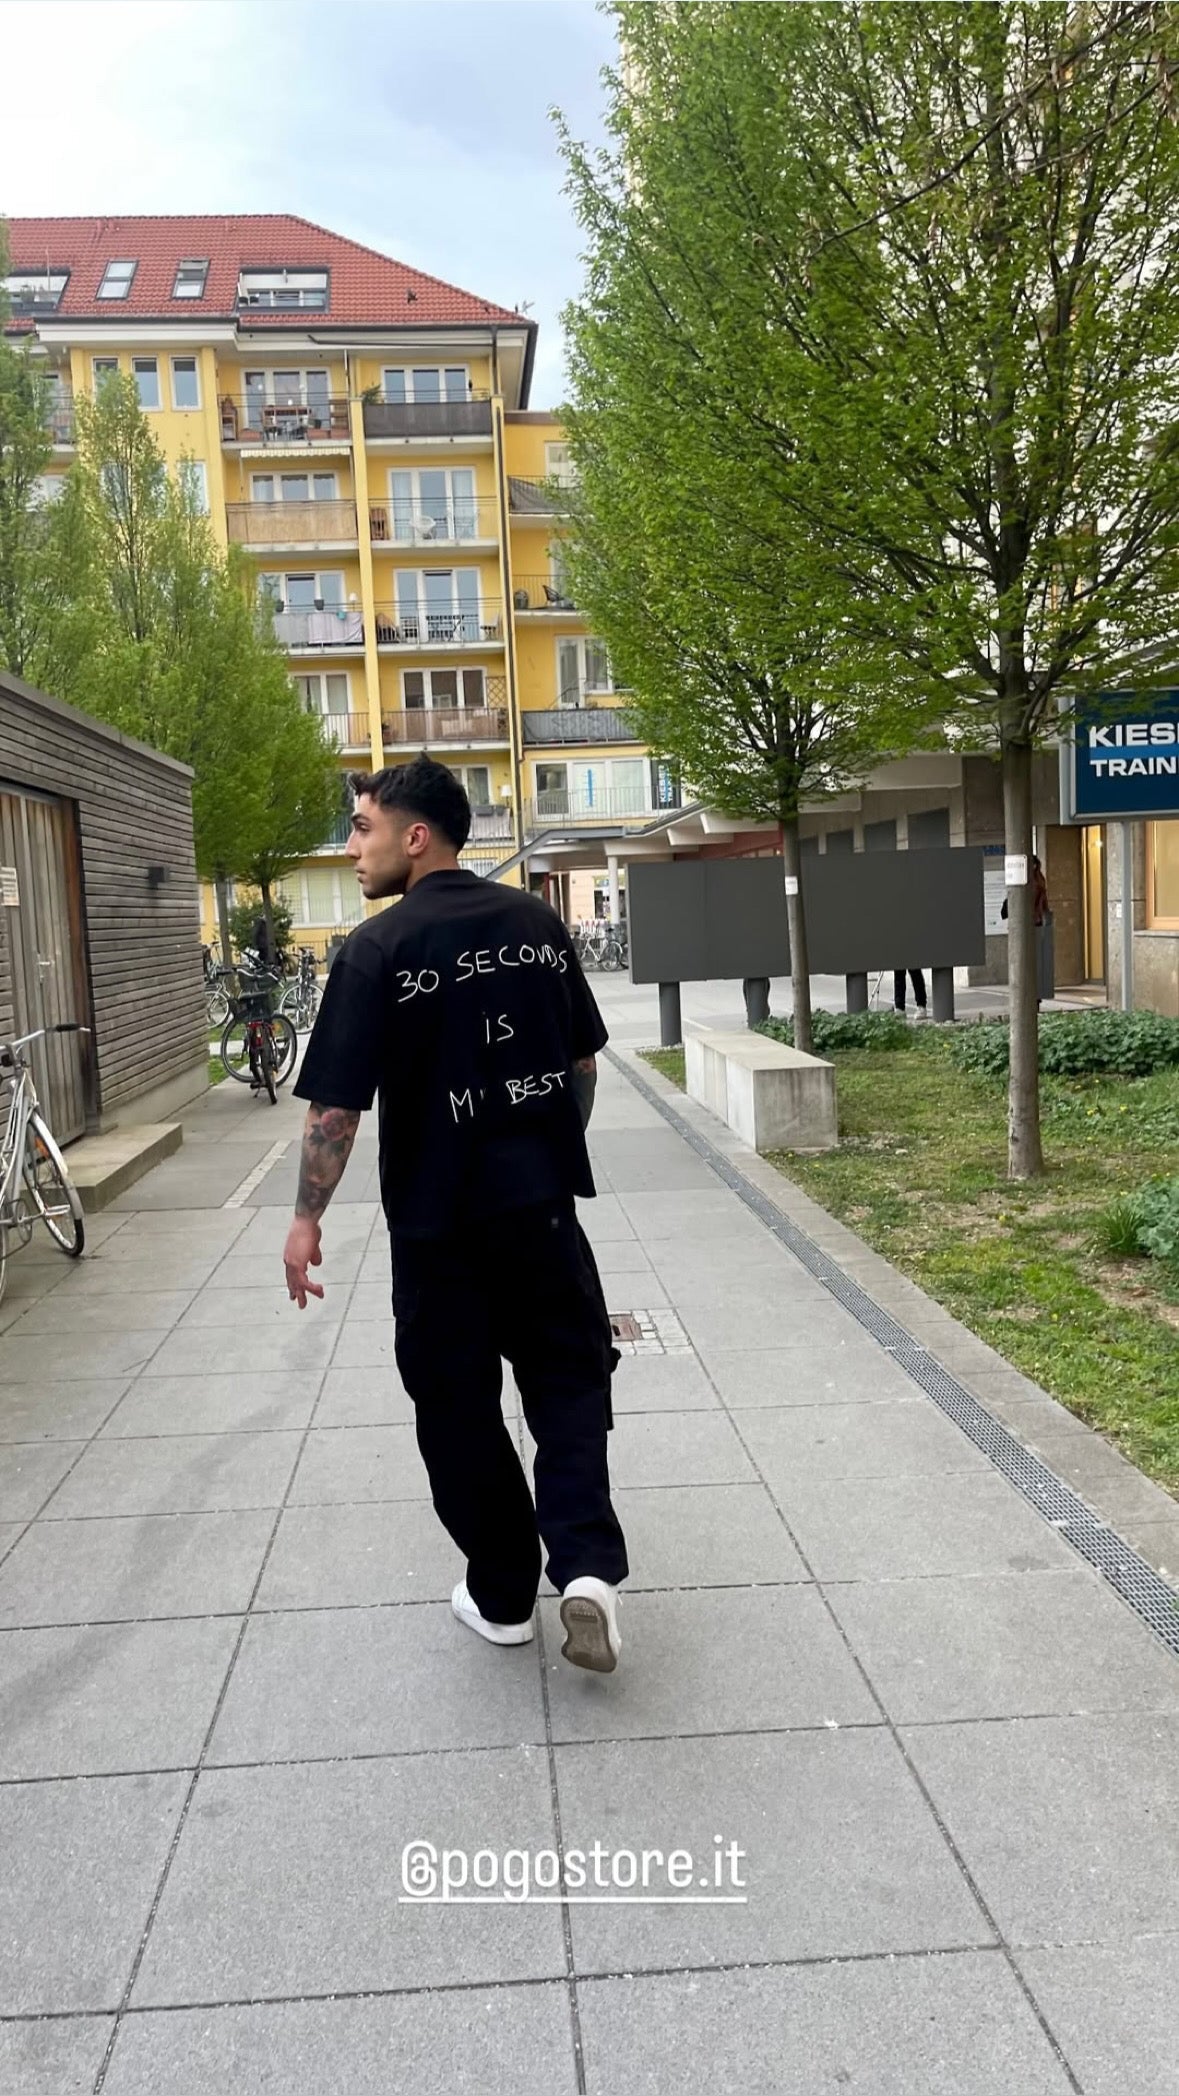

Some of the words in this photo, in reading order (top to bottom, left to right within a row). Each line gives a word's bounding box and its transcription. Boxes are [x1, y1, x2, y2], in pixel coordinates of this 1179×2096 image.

[1089, 722, 1179, 748] KIES
[396, 969, 440, 1003] 30
[455, 944, 568, 982] SECONDS
[505, 1071, 566, 1105] BEST
